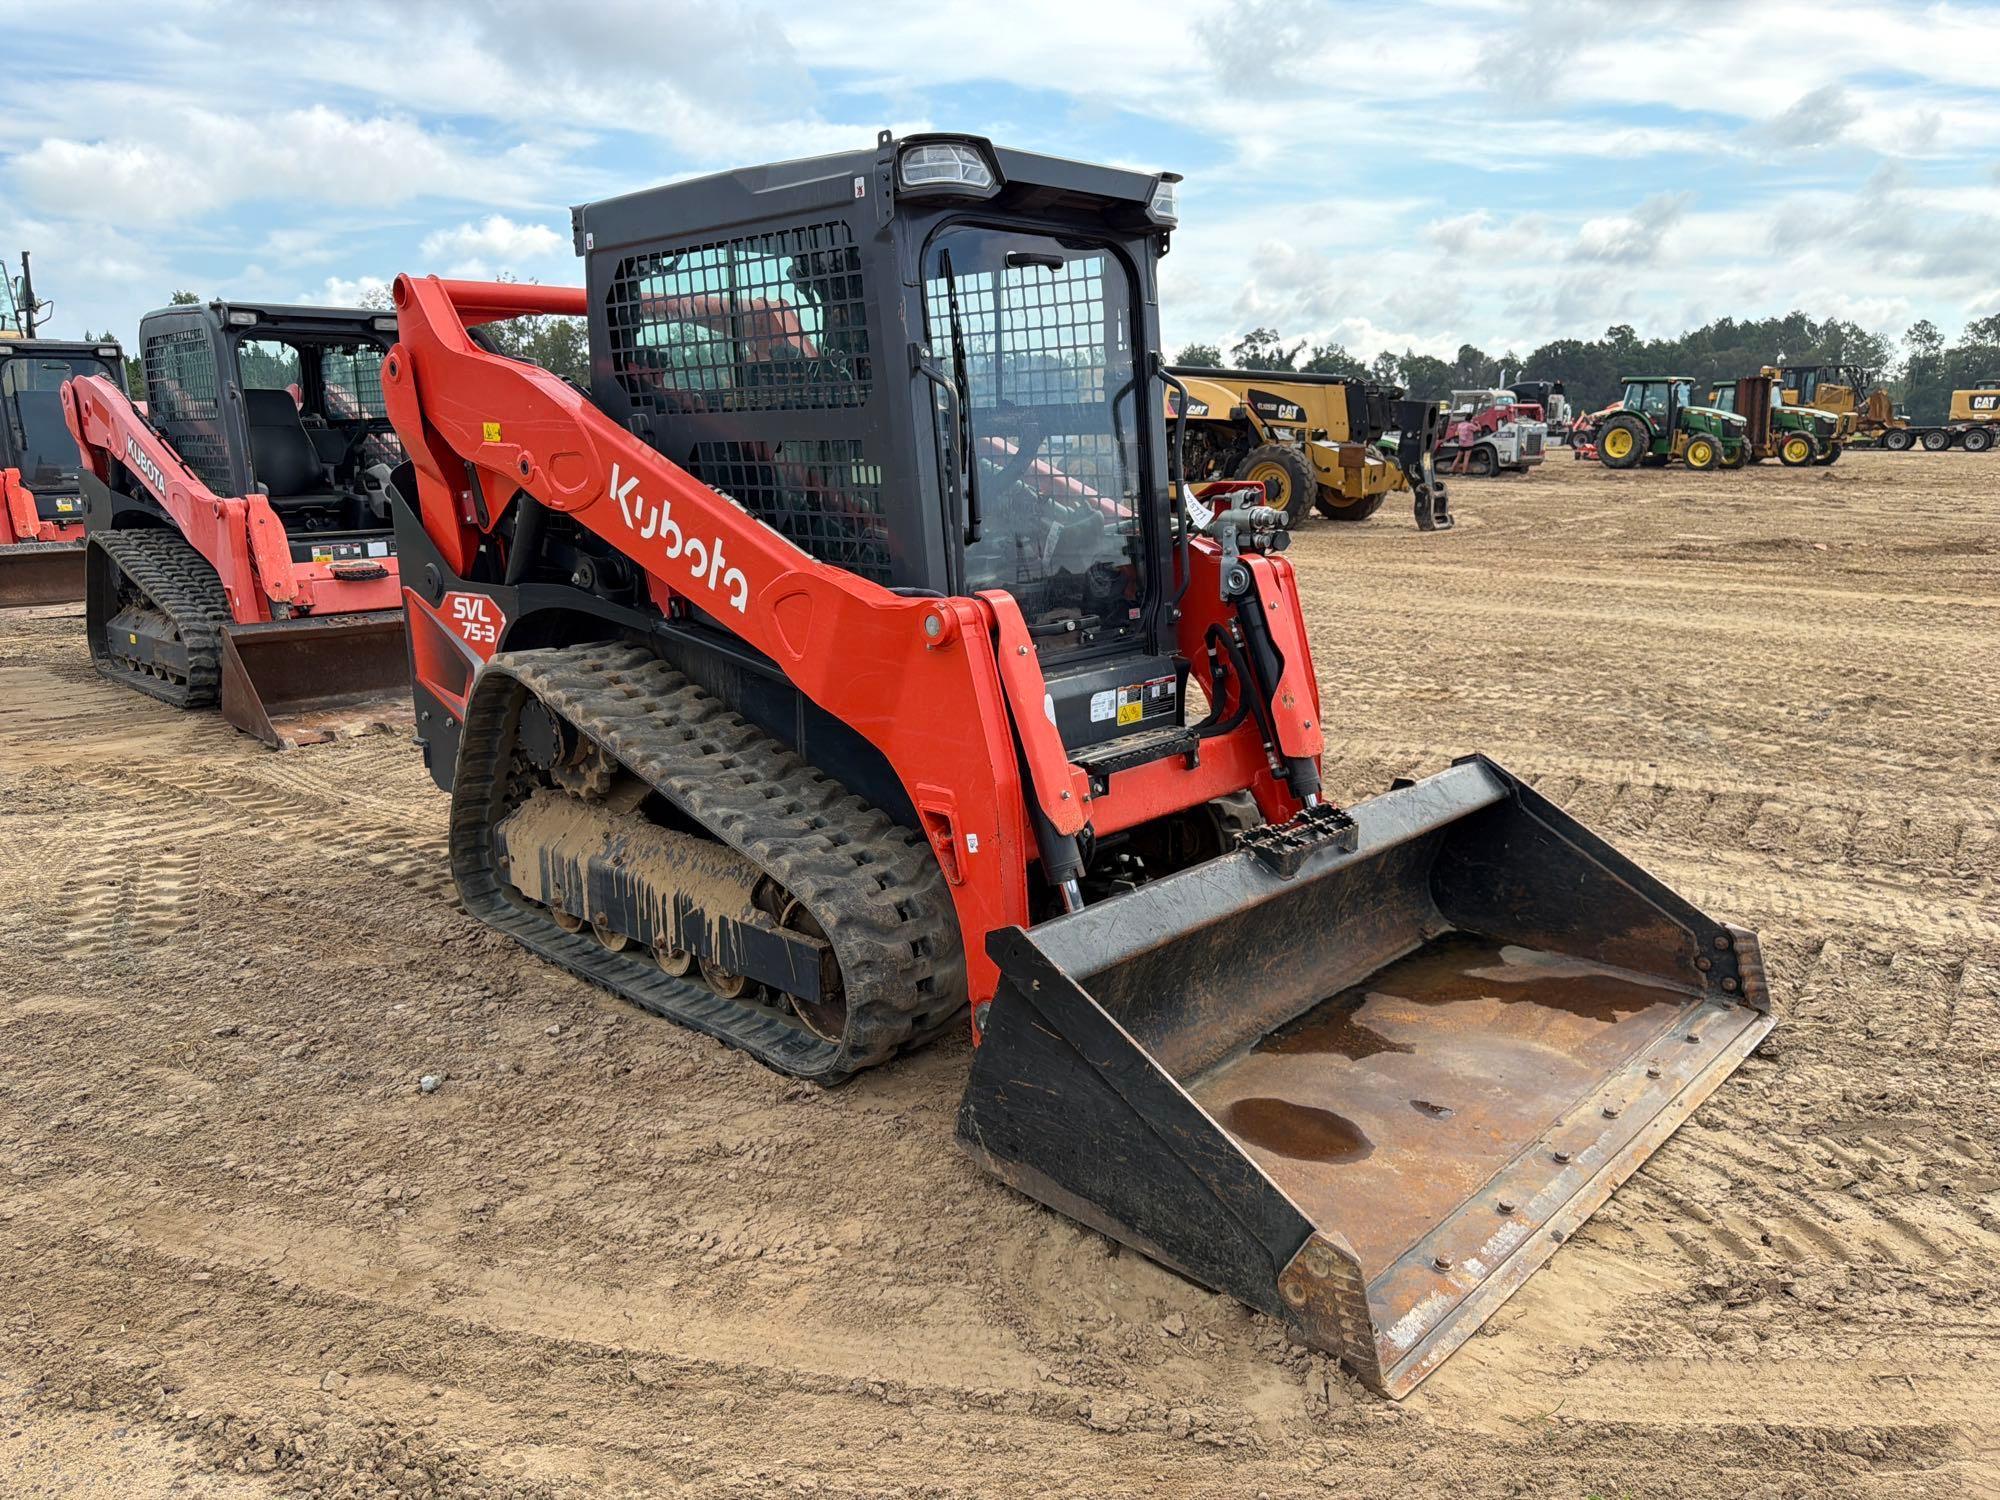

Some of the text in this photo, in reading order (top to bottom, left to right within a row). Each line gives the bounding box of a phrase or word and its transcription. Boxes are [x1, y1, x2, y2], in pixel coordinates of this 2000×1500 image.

[1187, 404, 1207, 415] CAT
[1278, 404, 1299, 419] CAT
[1974, 396, 1997, 409] CAT
[127, 436, 166, 497] KUBOTA
[609, 462, 748, 614] Kubota
[453, 597, 491, 623] SVL
[462, 621, 495, 643] 75-3
